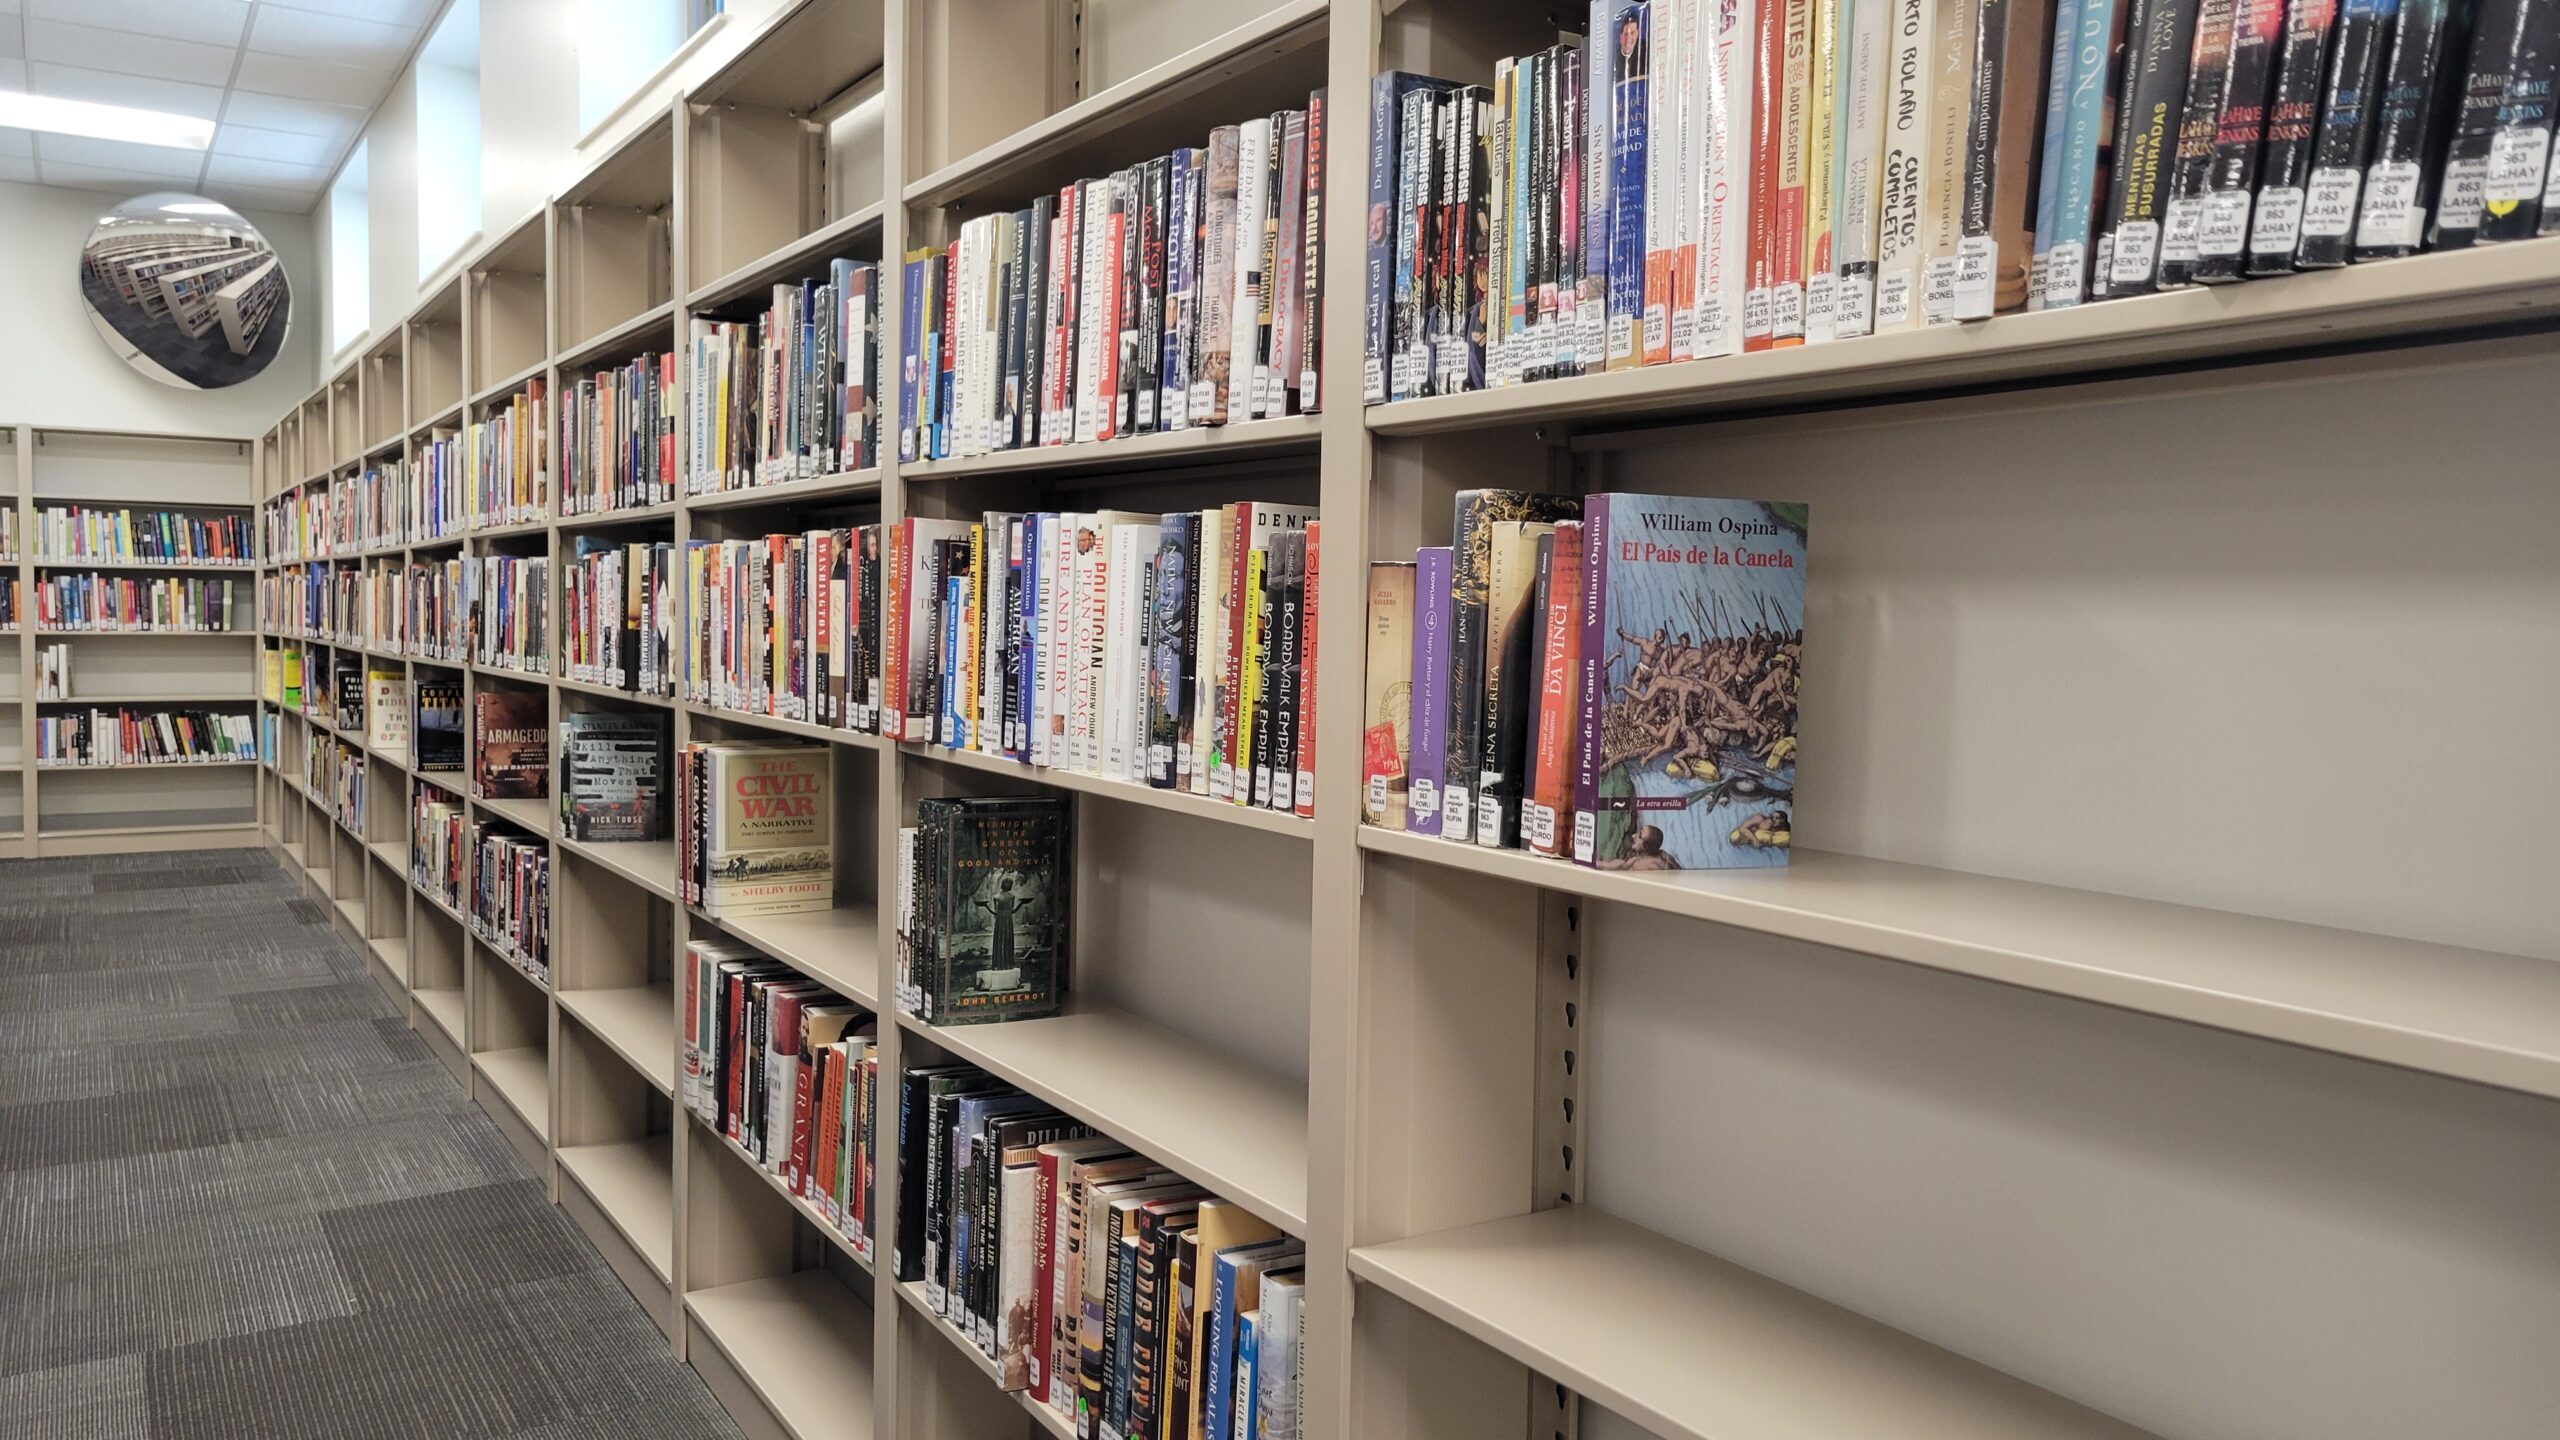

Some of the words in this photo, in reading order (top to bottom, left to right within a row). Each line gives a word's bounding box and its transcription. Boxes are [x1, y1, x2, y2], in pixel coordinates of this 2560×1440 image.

[2147, 11, 2165, 73] DIANNA
[2161, 7, 2177, 51] LOVE
[2127, 49, 2138, 81] Grande
[1857, 75, 1867, 129] MATILDE
[1897, 46, 1917, 131] BOLAÑO
[1406, 95, 1418, 128] Sopa
[1975, 60, 1993, 151] Campomanes
[1269, 129, 1279, 171] GERTZ
[1408, 131, 1418, 147] de
[1457, 97, 1473, 203] METAMORFOSIS
[1593, 124, 1603, 148] SIN
[1787, 87, 1801, 183] ADOLESCENTES
[1943, 107, 1956, 166] BONELLI
[1375, 145, 1383, 168] Phil
[1405, 150, 1417, 180] pollo
[1973, 154, 1986, 185] Rizo
[2066, 120, 2086, 220] BUSCANDO
[2139, 102, 2167, 215] SUSURRADAS
[1243, 138, 1256, 225] FRIEDMAN
[1592, 151, 1602, 199] MIRAR
[1703, 169, 1711, 190] Paso
[2124, 133, 2148, 217] MENTIRAS
[2490, 169, 2537, 181] LAHAY
[1403, 183, 1414, 212] para
[1882, 149, 1902, 262] COMPLETOS
[1900, 157, 1918, 248] CUENTOS
[1939, 170, 1952, 247] FLORENCIA
[1970, 188, 1986, 230] Esther
[2306, 205, 2348, 217] LAHAY
[2317, 190, 2340, 202] 863
[2363, 200, 2408, 211] LAHAY
[1084, 189, 1096, 268] RICHARD
[1493, 219, 1501, 243] Fred
[2254, 222, 2294, 235] LAHAY
[2265, 210, 2284, 219] 863
[1403, 228, 1415, 260] alma
[2124, 244, 2141, 253] 863
[1371, 260, 1380, 288] real
[1491, 245, 1500, 289] Stoeker
[1963, 261, 1978, 270] 863
[1028, 260, 1038, 320] ABUSE
[1810, 294, 1830, 304] 613.7
[1887, 294, 1900, 303] 863
[1936, 280, 1949, 288] 863
[2047, 279, 2078, 291] FERRA
[1081, 279, 1090, 346] REEVES
[1272, 258, 1291, 371] DEMOCRACY
[1745, 319, 1768, 329] GARCI
[1807, 304, 1834, 316] JACQU
[1837, 311, 1862, 322] ASENS
[1880, 303, 1907, 316] BOLAN
[817, 326, 828, 394] WHAT
[1088, 307, 1101, 400] KENNEDY
[1101, 331, 1111, 381] SCANDAL
[1024, 349, 1035, 415] POWER
[1591, 516, 1601, 565] Ospina
[1640, 513, 1712, 532] William
[1718, 517, 1778, 539] Ospina
[1060, 527, 1072, 578] FIRE
[1191, 544, 1199, 584] MONTHS
[1287, 543, 1295, 585] JOHNSON
[1622, 542, 1639, 561] El
[1645, 544, 1682, 564] País
[1686, 545, 1708, 564] de
[1714, 546, 1729, 565] la
[1735, 547, 1793, 568] Canela
[1166, 546, 1177, 593] NATIVE
[818, 543, 827, 636] WASHINGTON
[1037, 578, 1049, 633] DONALD
[1080, 569, 1093, 619] PLAN
[1458, 542, 1470, 643] JEAN-CHRISTOPHE
[1588, 570, 1598, 627] William
[1058, 585, 1069, 634] AND
[1091, 562, 1108, 669] POLITICIAN
[1164, 599, 1174, 633] NEW
[887, 589, 898, 667] AMATEUR
[928, 604, 937, 680] AMENDMENTS
[1010, 586, 1022, 675] AMERICAN
[1079, 628, 1090, 654] OF
[1425, 632, 1434, 655] Harry
[1552, 604, 1567, 660] VINCI
[1035, 642, 1047, 691] TRUMP
[1055, 641, 1068, 698] FURY
[1259, 602, 1273, 704] BOARDWALK
[1279, 602, 1294, 705] BOARDWALK
[1162, 640, 1173, 705] YORKERS
[1549, 667, 1563, 696] DA
[1585, 659, 1595, 703] Canela
[1077, 662, 1090, 737] ATTACK
[1487, 665, 1500, 729] SECRETA
[1585, 707, 1592, 718] la
[1088, 710, 1096, 739] YOUNG
[1422, 730, 1430, 751] fuego
[1584, 722, 1592, 738] de
[582, 742, 611, 751] Kill
[590, 754, 651, 765] Anything
[1583, 742, 1592, 768] País
[594, 778, 632, 786] Moves
[618, 767, 648, 776] That
[759, 760, 796, 772] THE
[1583, 774, 1591, 785] El
[736, 774, 820, 796] CIVIL
[590, 816, 611, 824] NICK
[617, 816, 642, 824] TURSE
[738, 797, 818, 819] WAR
[1446, 815, 1462, 823] RUFIN
[1636, 800, 1645, 808] La
[1662, 800, 1682, 808] orilla
[752, 819, 816, 829] NARRATIVE
[978, 821, 1036, 829] MIDNIGHT
[1537, 822, 1546, 830] 863
[982, 840, 1030, 848] GARDEN
[1576, 838, 1591, 847] OSPIN
[958, 860, 990, 868] GOOD
[998, 859, 1020, 867] AND
[1026, 858, 1051, 866] EVIL
[743, 885, 785, 897] SHELBY
[789, 883, 825, 893] FOOTE
[956, 996, 987, 1007] JOHN
[993, 993, 1045, 1005] BERENDT
[793, 1073, 808, 1166] GRANT
[928, 1094, 937, 1123] PATH
[927, 1138, 936, 1209] DESTRUCTION
[1110, 1213, 1120, 1250] INDIAN
[1108, 1251, 1119, 1273] WAR
[1120, 1254, 1132, 1318] ASTORIA
[1105, 1275, 1117, 1340] VETERANS
[1211, 1280, 1224, 1361] LOOKING
[1208, 1362, 1220, 1394] FOR
[1237, 1376, 1246, 1421] MIRACLE
